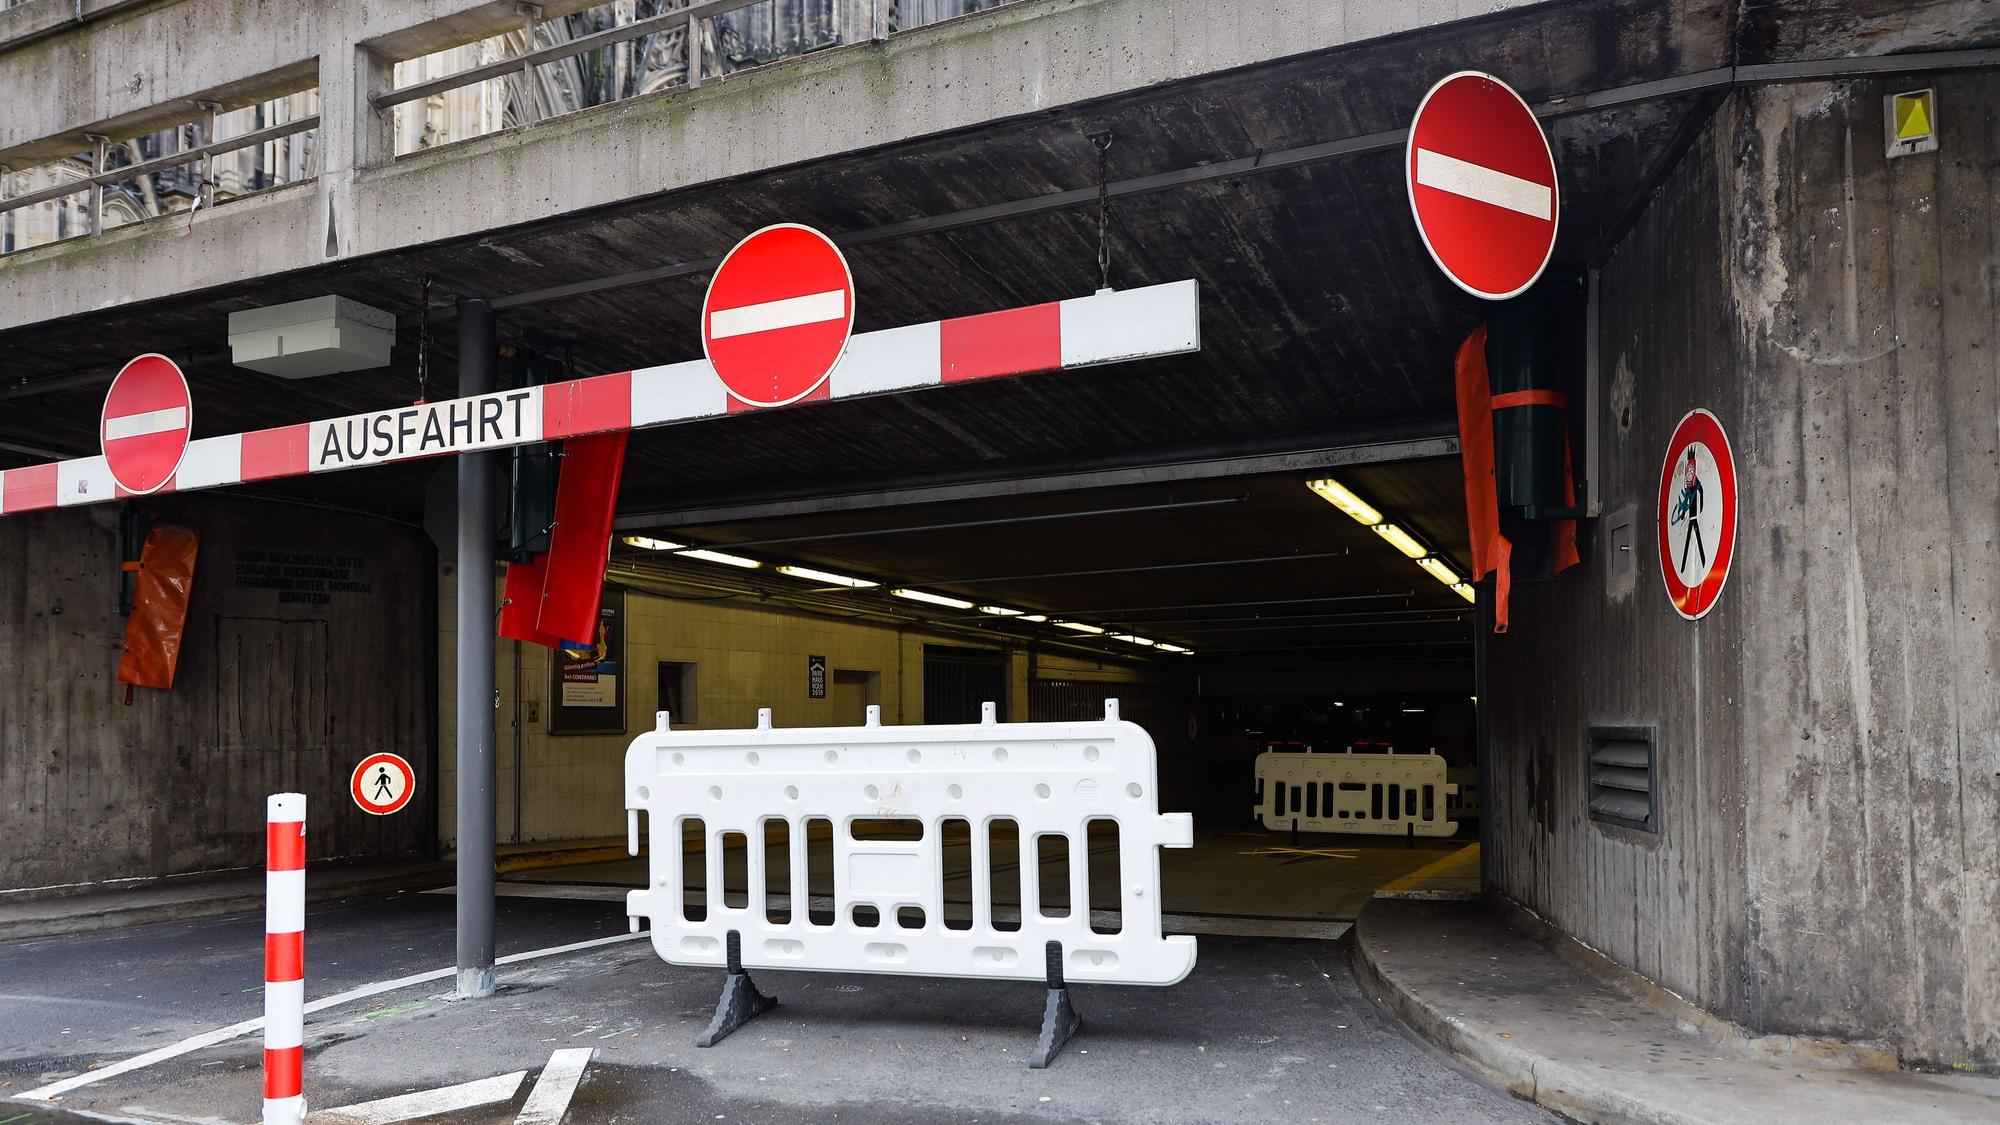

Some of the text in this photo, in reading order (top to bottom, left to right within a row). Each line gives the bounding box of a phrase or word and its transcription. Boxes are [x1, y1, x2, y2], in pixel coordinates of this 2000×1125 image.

[320, 392, 530, 465] AUSFAHRT
[336, 557, 363, 569] BITTE
[296, 580, 325, 592] HOTEL
[329, 581, 372, 594] MONDIAL
[279, 591, 331, 604] BENUTZEN
